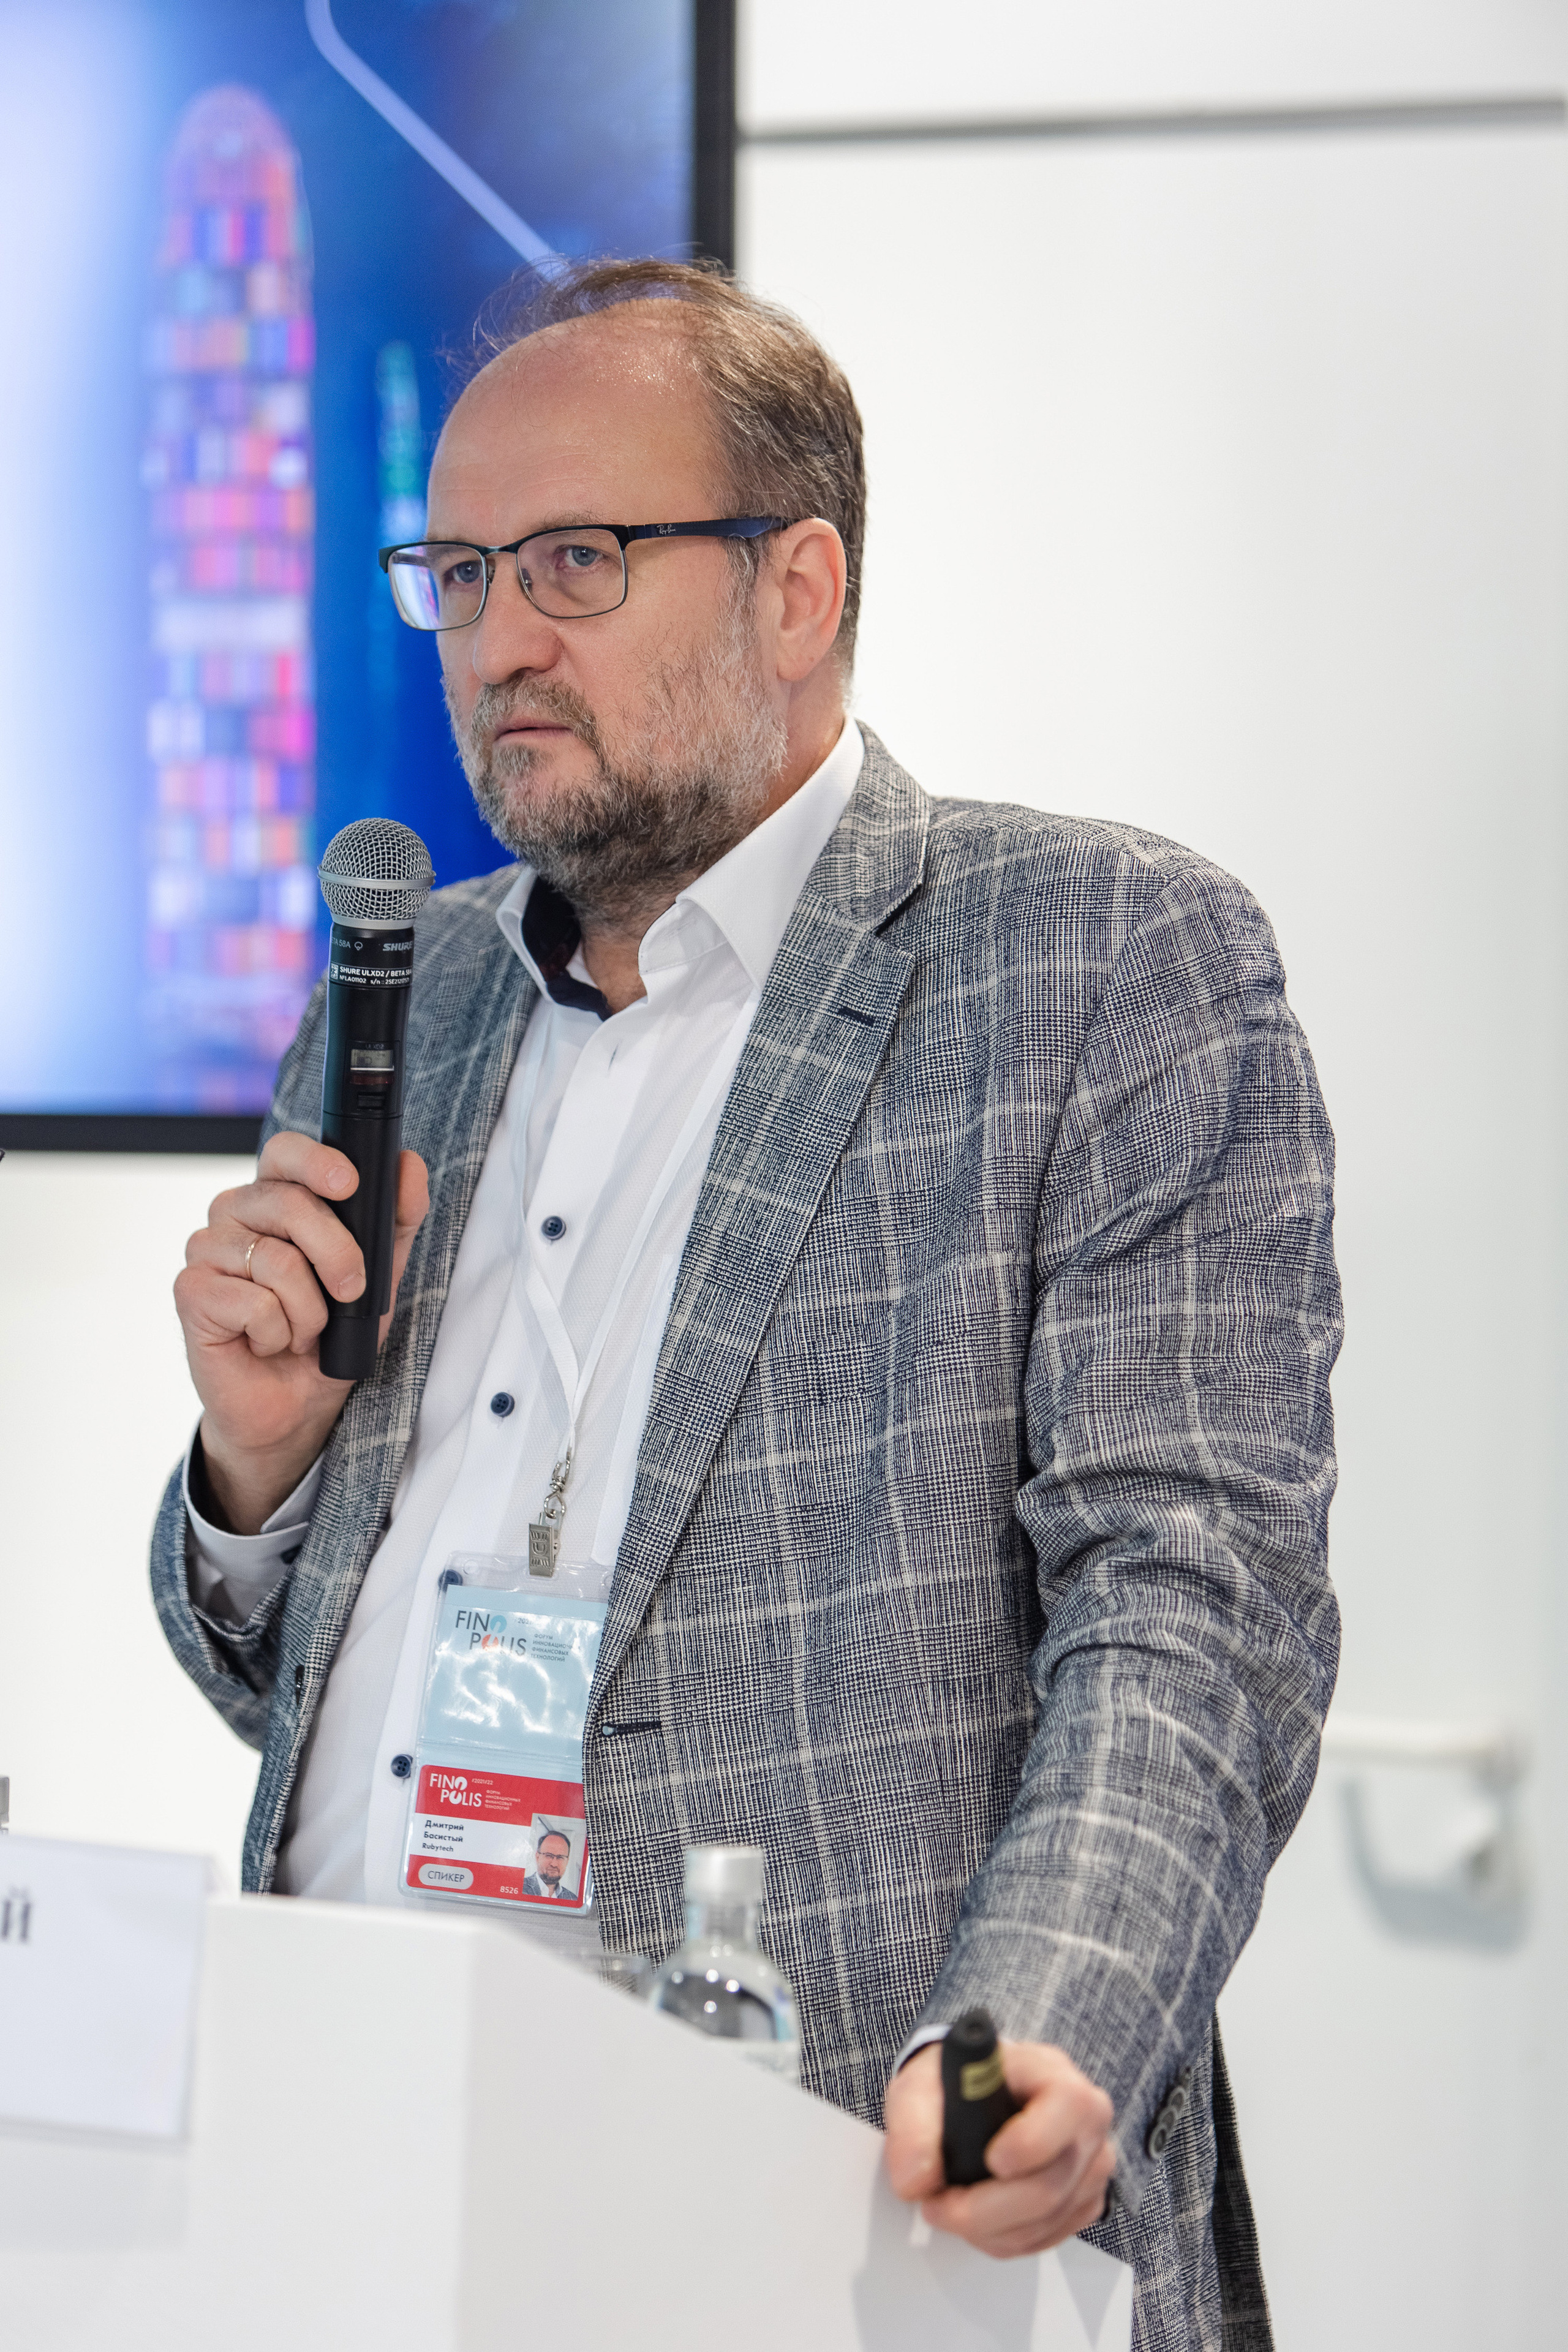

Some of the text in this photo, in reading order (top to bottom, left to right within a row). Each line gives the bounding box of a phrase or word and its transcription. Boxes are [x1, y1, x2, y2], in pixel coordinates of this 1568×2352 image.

[339, 939, 351, 949] 58A
[382, 941, 413, 952] SHURE
[339, 966, 360, 975] SHURE
[532, 1646, 568, 1656] ФИНАНСОВЫХ
[440, 1789, 482, 1807] POLIS
[424, 1820, 464, 1831] Дмитрий
[424, 1831, 463, 1842] Басистый
[422, 1842, 454, 1852] Rubytech
[428, 1870, 465, 1883] СПИКЕР
[500, 1885, 518, 1894] 8526
